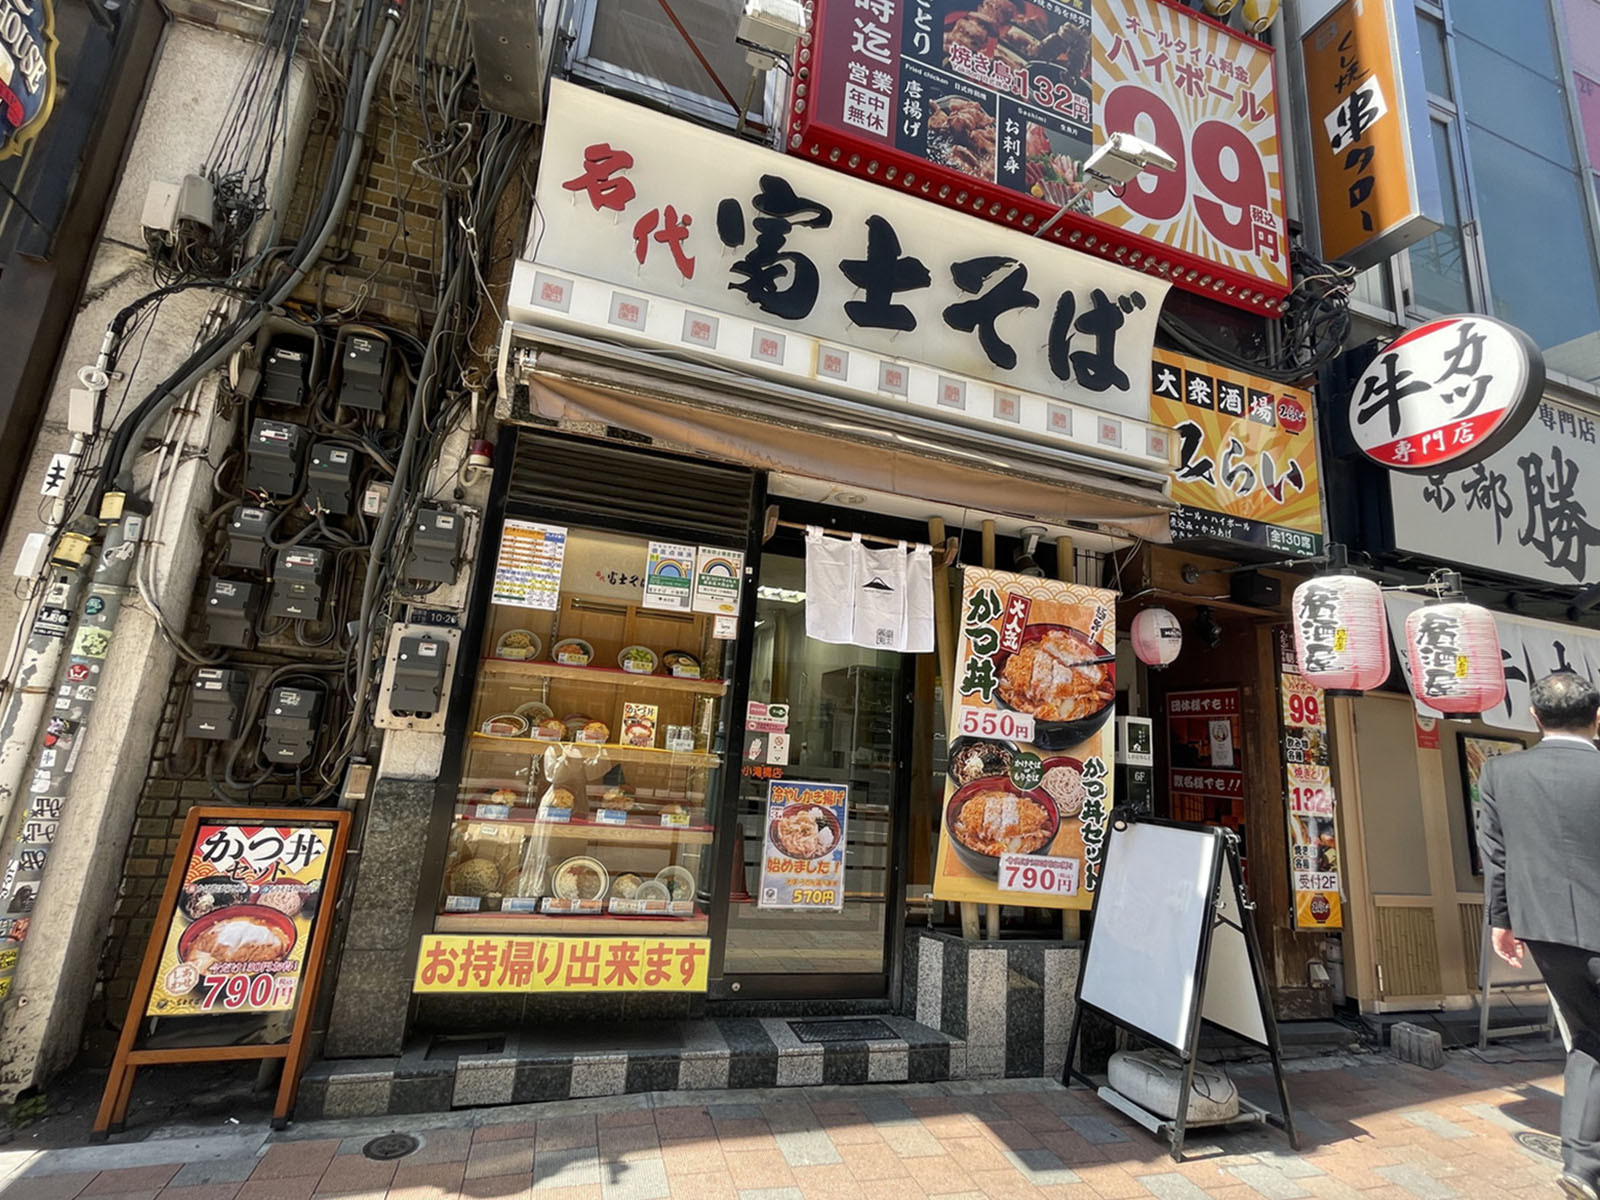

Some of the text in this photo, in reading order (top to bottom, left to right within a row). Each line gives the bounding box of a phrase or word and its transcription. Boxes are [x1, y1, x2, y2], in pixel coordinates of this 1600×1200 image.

[905, 63, 923, 76] Fried
[950, 44, 1013, 87] 焼き鳥
[1126, 17, 1250, 84] オールタイム料金
[848, 61, 893, 95] 営業
[848, 87, 885, 112] 年中
[1107, 34, 1265, 123] ハイボール
[847, 105, 884, 131] 無休
[903, 80, 924, 138] 唐揚げ
[1003, 117, 1020, 174] お刺身
[562, 143, 1146, 393] 名代 富士そば
[1155, 368, 1274, 423] 大衆酒場
[1357, 322, 1494, 438] 牛カツ
[1391, 421, 1475, 462] 専門店
[1538, 403, 1596, 444] 専門店
[960, 588, 1004, 703] かつ丼
[1002, 599, 1026, 650] 大人気
[1299, 585, 1346, 674] 居酒屋
[1416, 613, 1468, 698] 居酒屋
[963, 711, 1029, 739] 550円
[1079, 757, 1108, 892] かつ丼セット
[202, 831, 322, 867] かつ丼
[226, 861, 287, 883] セット
[1005, 866, 1072, 892] 790円
[1299, 874, 1336, 889] 受付2F
[791, 889, 835, 905] 570円
[421, 939, 706, 988] お持帰り出来ます
[202, 973, 293, 1010] 790円
